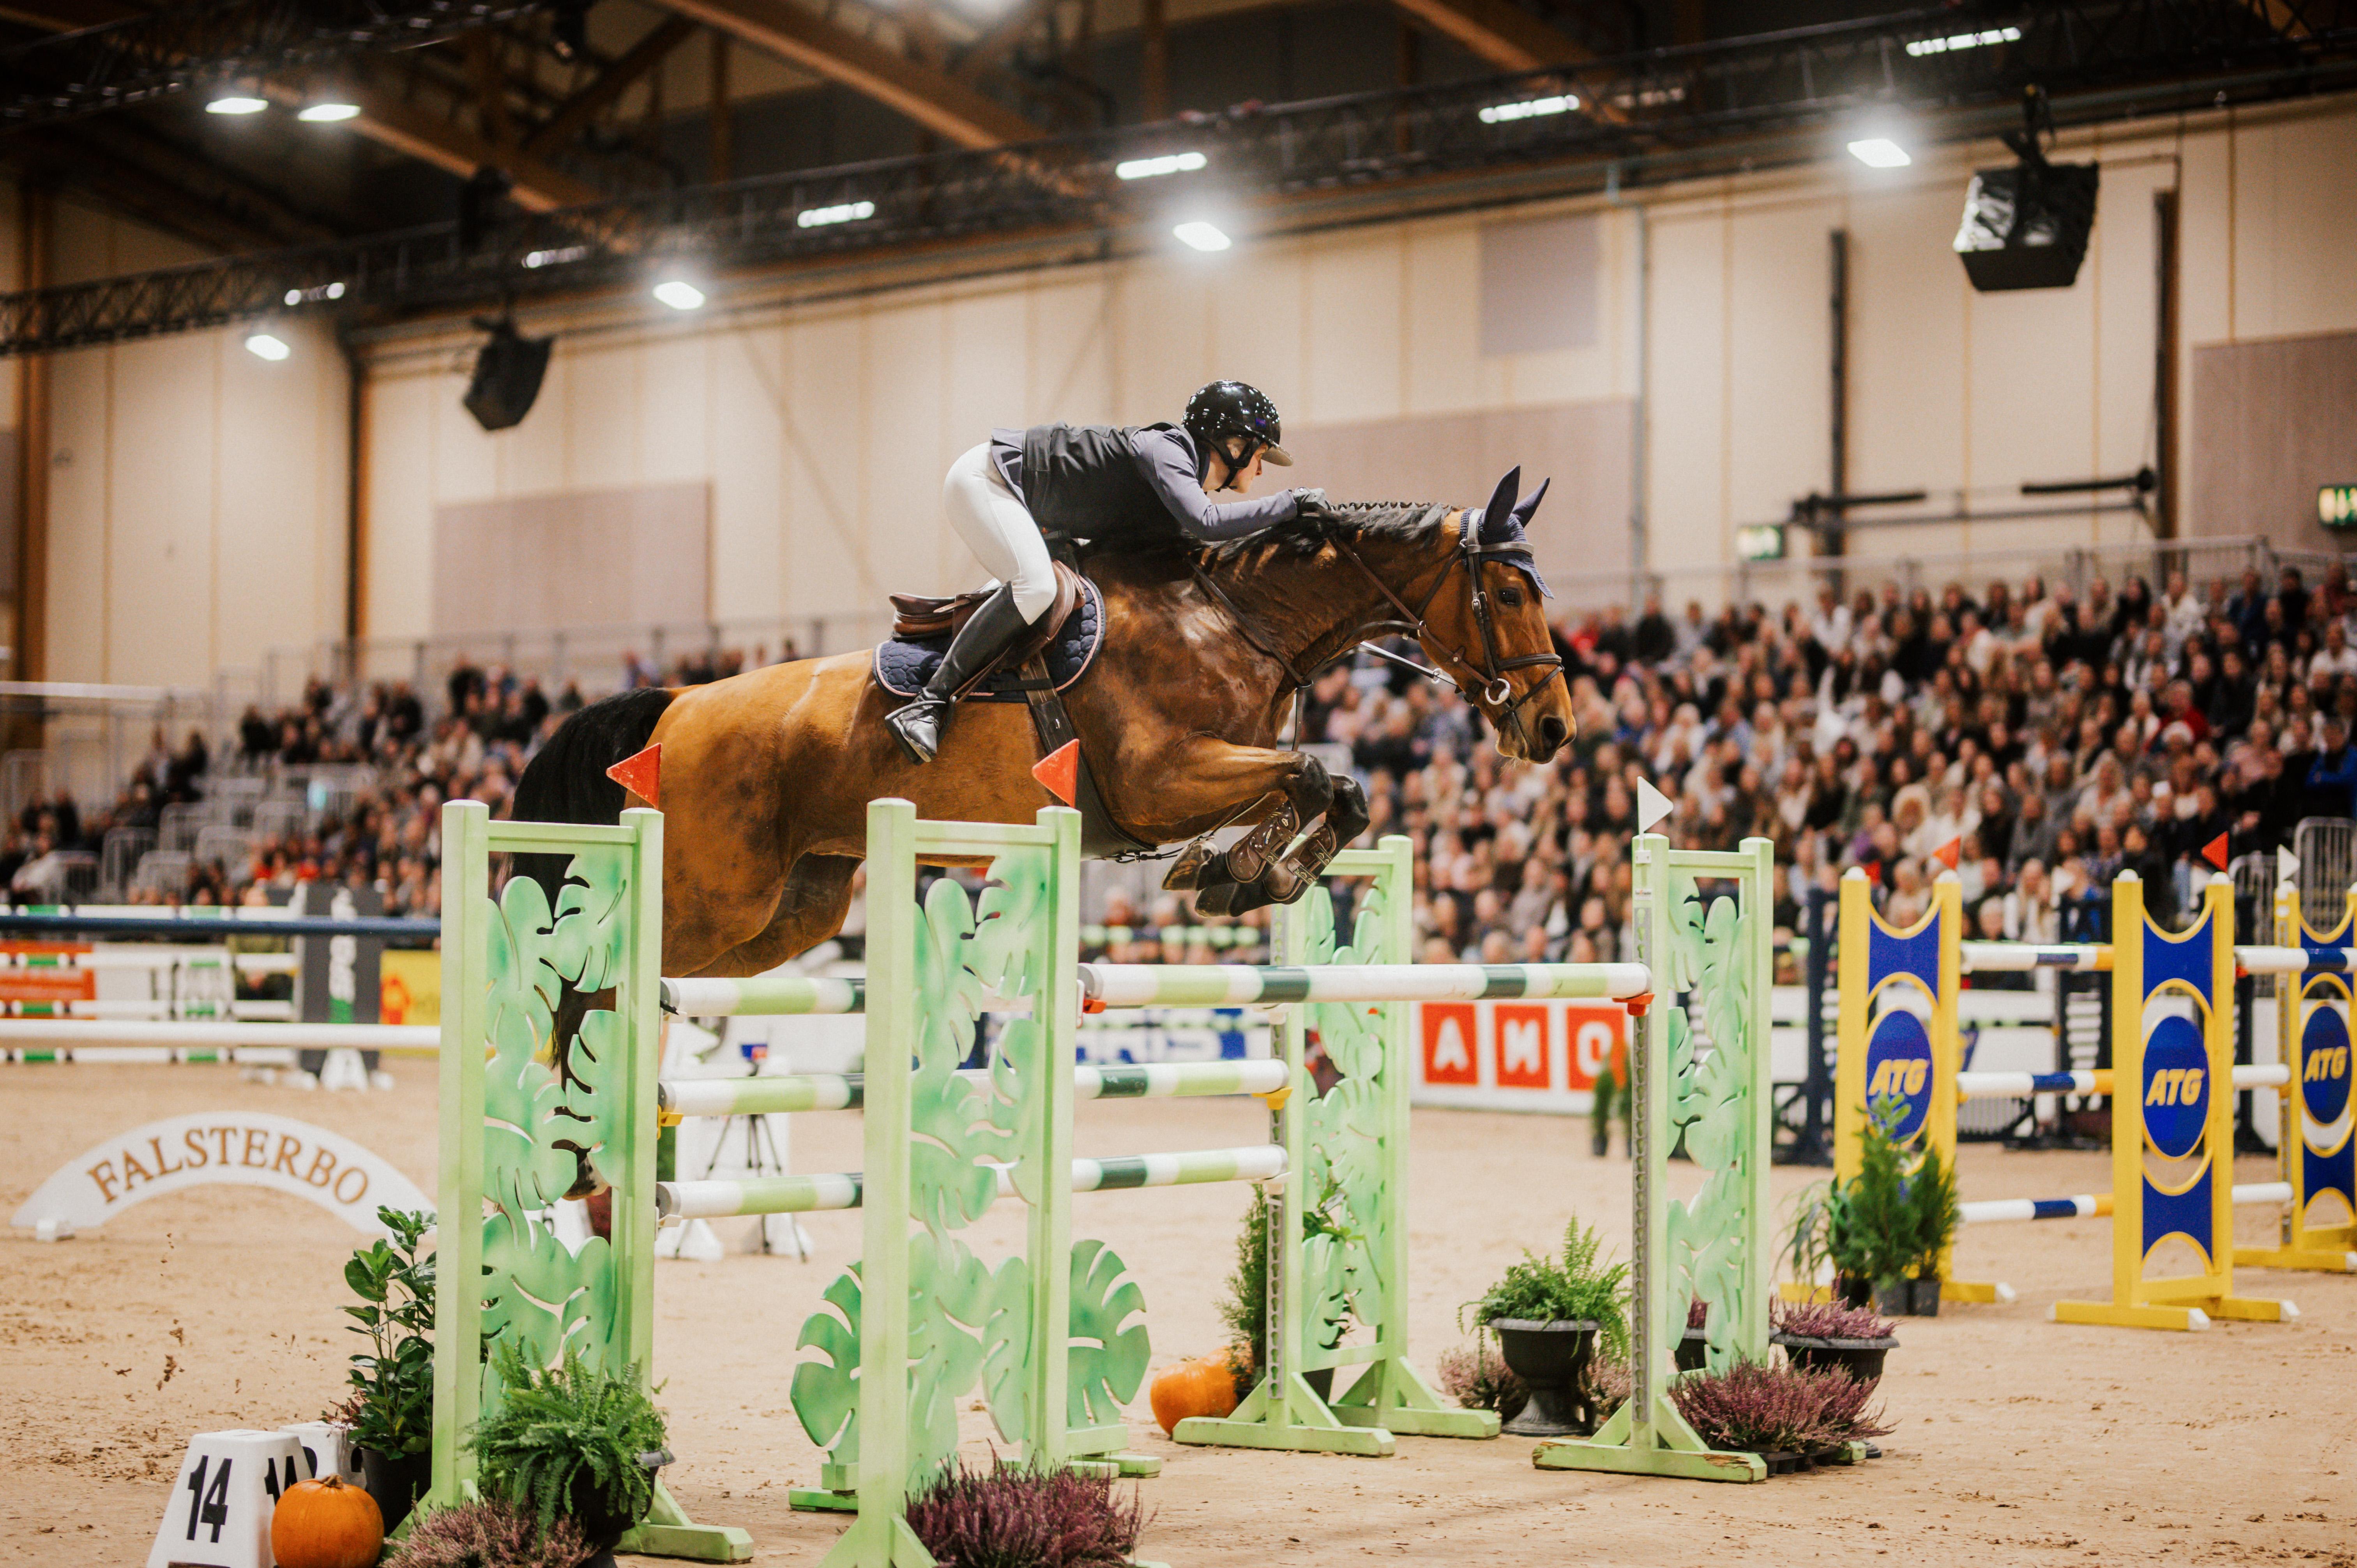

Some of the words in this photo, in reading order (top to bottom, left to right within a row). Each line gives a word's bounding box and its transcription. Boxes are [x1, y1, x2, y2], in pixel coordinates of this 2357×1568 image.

[1868, 1059, 1927, 1095] ATG
[2304, 1046, 2347, 1083] ATG
[2145, 1068, 2203, 1106] ATG
[87, 1126, 370, 1205] FALSTERBO
[187, 1455, 232, 1543] 14
